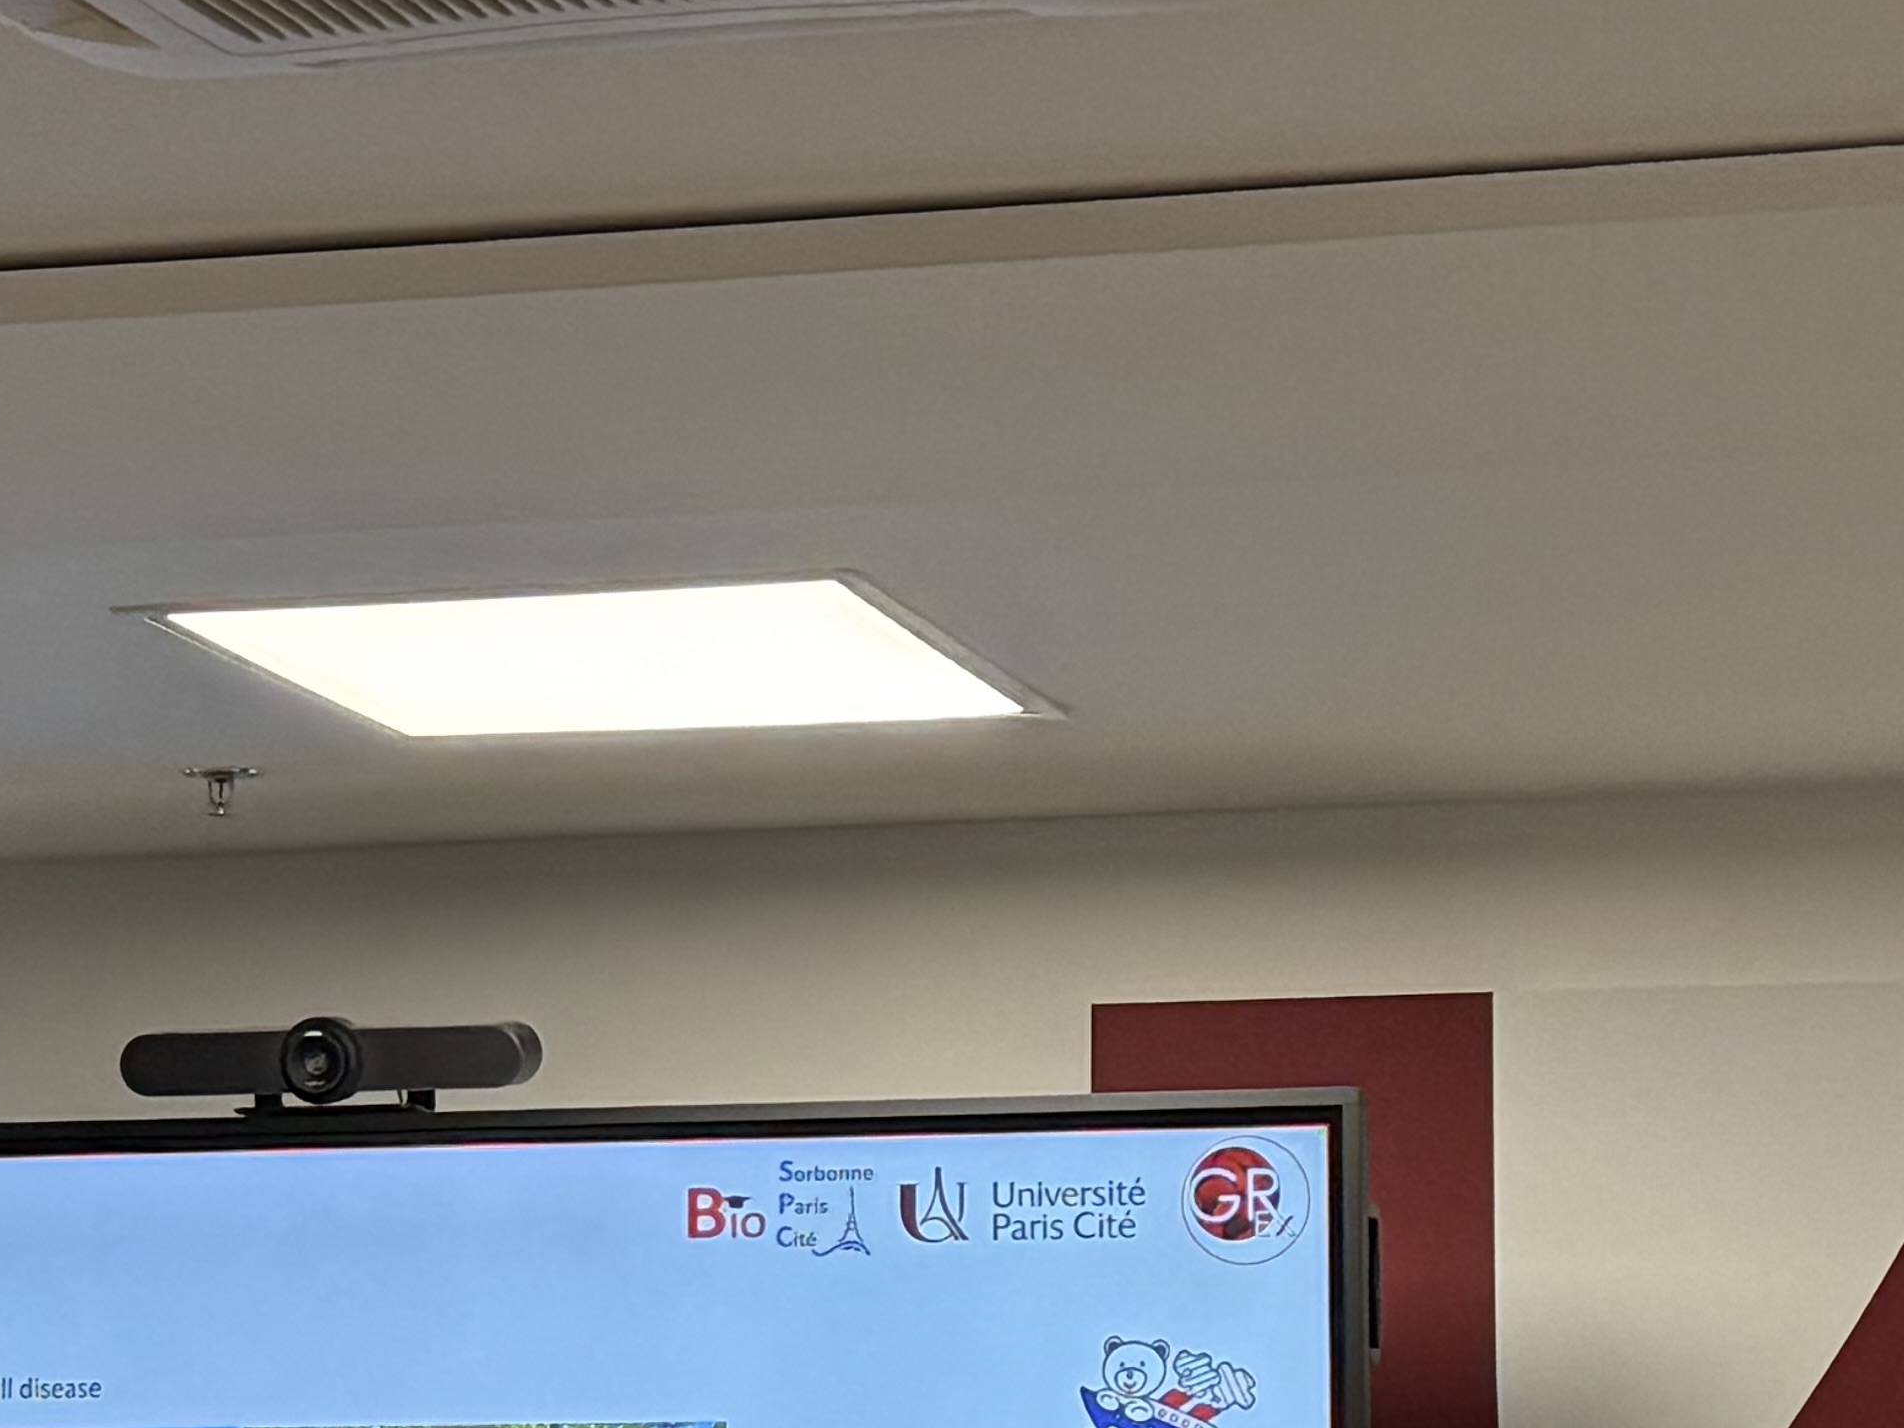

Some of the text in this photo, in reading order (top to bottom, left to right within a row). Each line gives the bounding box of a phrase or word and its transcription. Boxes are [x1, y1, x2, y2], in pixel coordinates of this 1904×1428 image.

[778, 1160, 874, 1182] Sorbonne
[779, 1192, 828, 1215] Paris
[992, 1176, 1146, 1209] Université
[776, 1226, 817, 1248] Cité
[992, 1209, 1137, 1242] Paris Cité
[19, 1376, 102, 1400] disease
